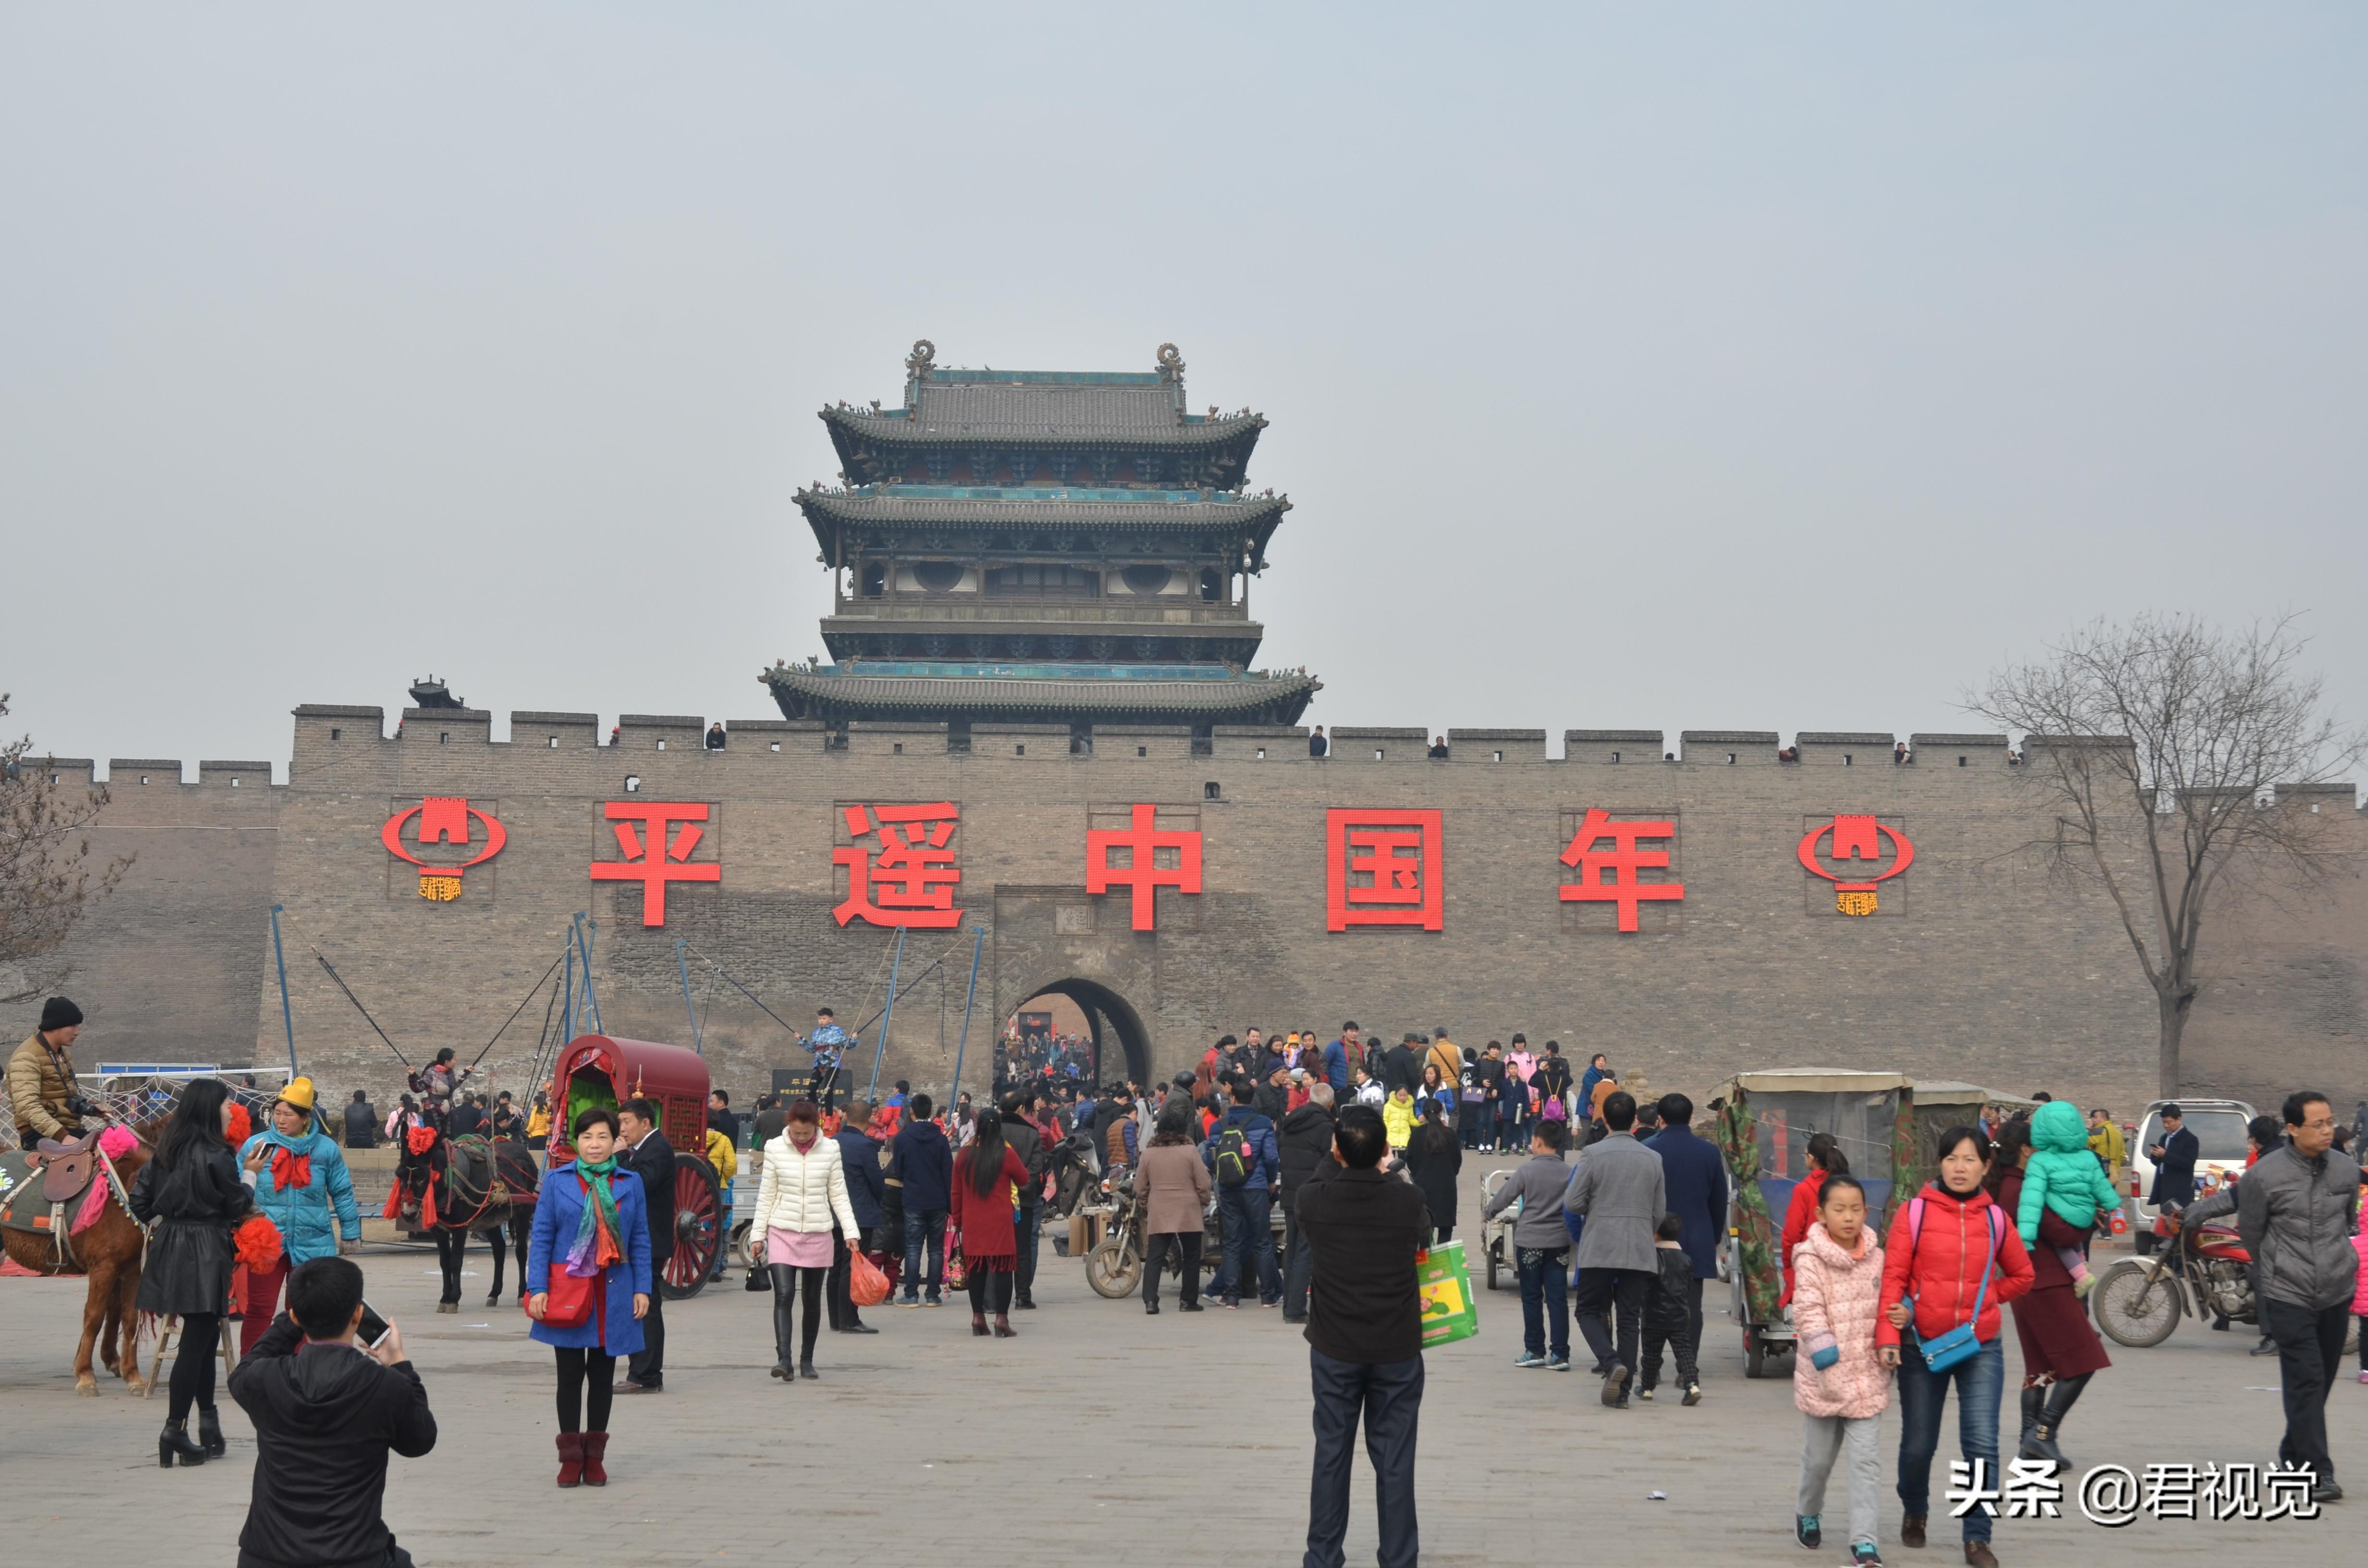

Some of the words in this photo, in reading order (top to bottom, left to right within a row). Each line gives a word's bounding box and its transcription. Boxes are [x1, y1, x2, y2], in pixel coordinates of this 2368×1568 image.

[590, 801, 1685, 932] 平遥中国年
